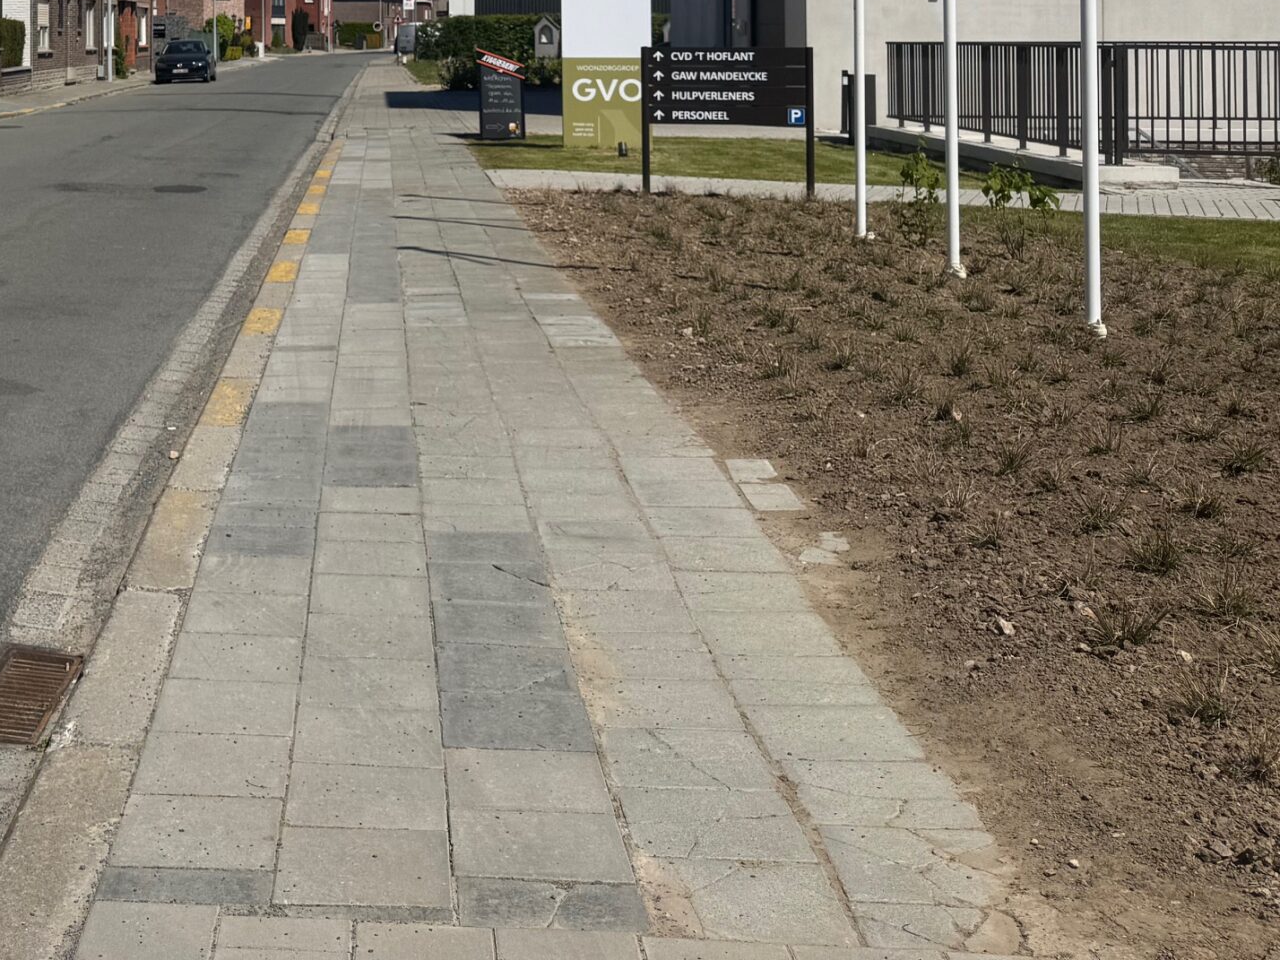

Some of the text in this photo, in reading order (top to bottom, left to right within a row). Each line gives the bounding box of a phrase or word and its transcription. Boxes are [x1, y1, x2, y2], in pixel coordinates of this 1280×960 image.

[670, 51, 693, 61] CVD
[706, 51, 755, 61] HOFLANT
[576, 64, 640, 72] WOONZORGGROEP
[671, 71, 768, 82] GAW MANDELYCKE
[572, 77, 642, 102] GVO
[671, 91, 755, 101] HULPVERLENERS
[671, 110, 730, 121] PERSONEEL
[790, 109, 802, 124] P
